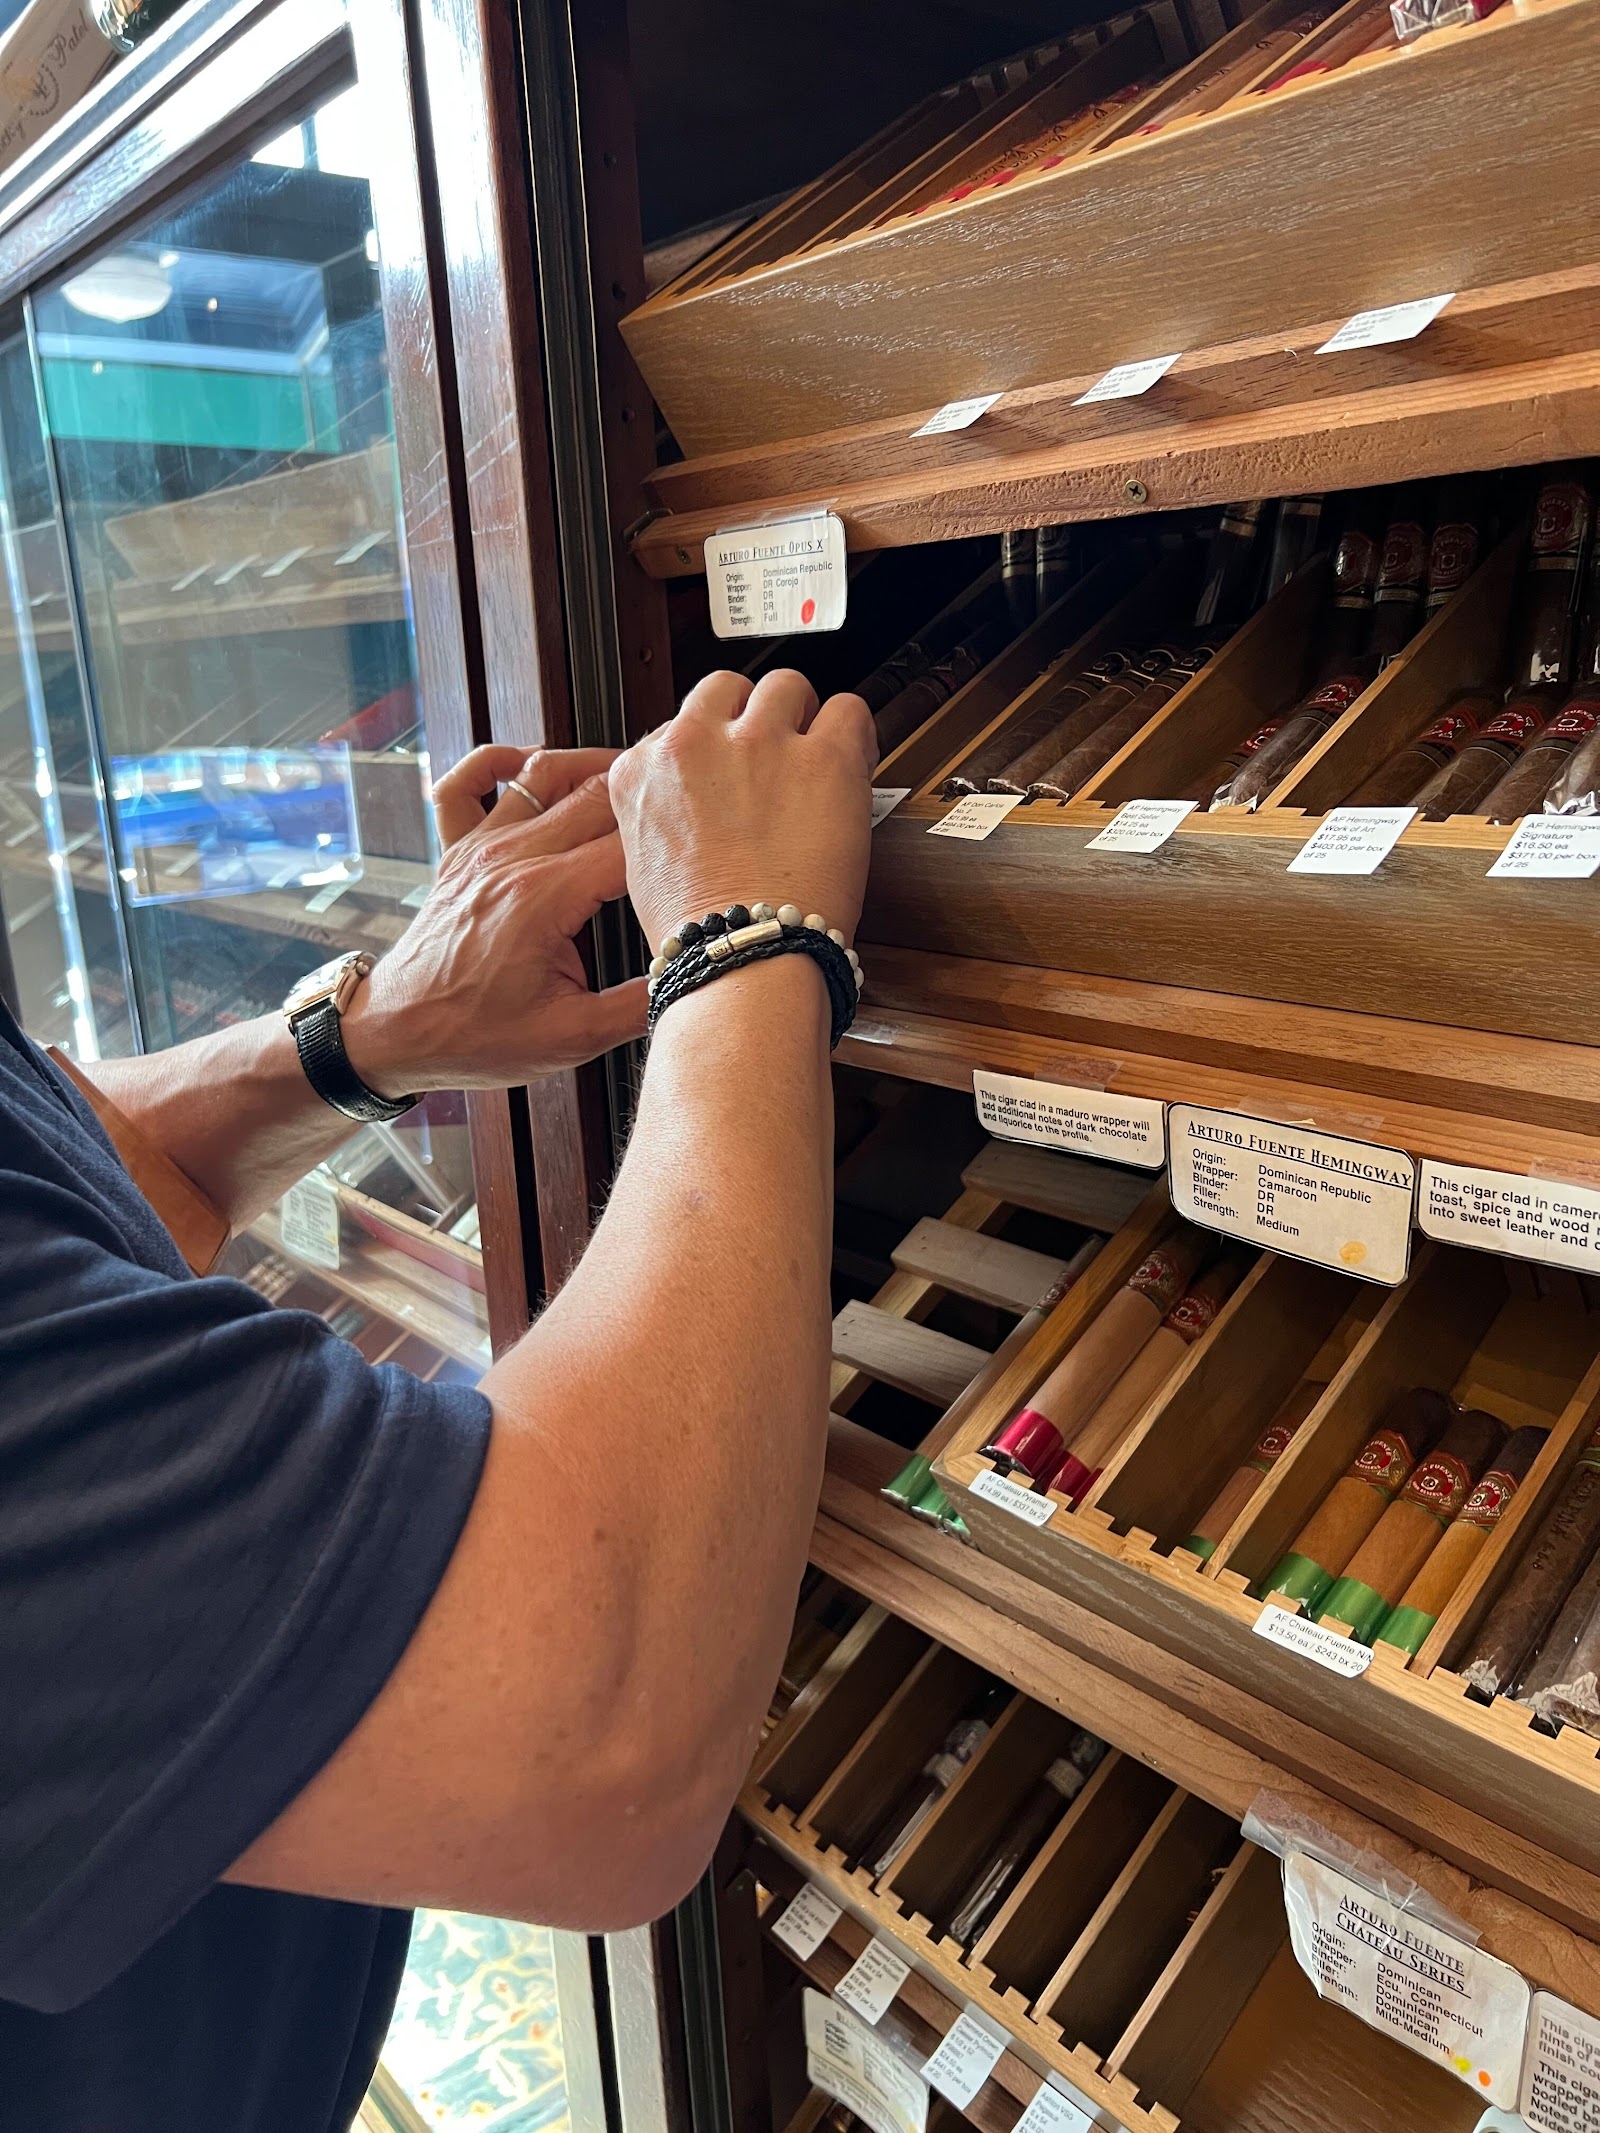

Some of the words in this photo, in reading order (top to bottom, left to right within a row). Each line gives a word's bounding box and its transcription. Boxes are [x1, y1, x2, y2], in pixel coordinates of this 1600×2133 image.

[817, 539, 823, 550] X
[726, 573, 744, 583] Origin:
[763, 566, 797, 578] Dominican
[800, 561, 833, 574] Republic
[763, 580, 773, 589] DR
[776, 578, 799, 587] Corojo
[763, 591, 773, 599] DR
[763, 602, 774, 611] DR
[764, 613, 778, 622] Full
[1141, 805, 1184, 813] Hemingway
[1345, 816, 1400, 825] Hemingway
[1325, 824, 1348, 832] Work
[1520, 832, 1574, 840] Signature
[1545, 823, 1600, 831] Hemingwa
[1310, 842, 1348, 850] $403.00
[1508, 851, 1553, 860] $371.00
[1514, 841, 1552, 849] $16.50
[980, 1089, 997, 1102] This
[998, 1094, 1018, 1108] cigar
[1019, 1098, 1036, 1110] clad
[1038, 1101, 1046, 1112] in
[1055, 1105, 1090, 1121] maduro
[1092, 1112, 1130, 1129] wrapper
[1132, 1120, 1150, 1131] will
[982, 1101, 996, 1112] add
[998, 1105, 1036, 1121] additional
[1038, 1112, 1063, 1126] notes
[1064, 1118, 1074, 1128] of
[1076, 1120, 1097, 1133] dark
[1099, 1126, 1147, 1142] chocolate
[983, 1111, 997, 1122] and
[1034, 1123, 1043, 1133] to
[1045, 1124, 1060, 1135] the
[1187, 1121, 1243, 1145] ARTURO
[1249, 1134, 1306, 1160] FUENTE
[1311, 1148, 1412, 1187] HEMINGWAY
[1192, 1148, 1227, 1167] Origin:
[1259, 1164, 1318, 1190] Dominican
[1320, 1180, 1372, 1204] Republic
[1192, 1159, 1239, 1182] Wrapper:
[1258, 1177, 1318, 1202] Camaroon
[1192, 1171, 1228, 1191] Binder:
[1257, 1190, 1275, 1203] DR
[1430, 1175, 1459, 1192] This
[1462, 1184, 1498, 1200] cigar
[1501, 1190, 1530, 1206] clad
[1535, 1196, 1548, 1210] in
[1193, 1183, 1221, 1201] Filler:
[1257, 1202, 1274, 1216] DR
[1193, 1195, 1239, 1219] Strength:
[1256, 1214, 1300, 1237] Medium
[1430, 1190, 1467, 1209] toast,
[1473, 1200, 1511, 1216] spice
[1517, 1209, 1543, 1223] and
[1550, 1216, 1590, 1234] wood
[1429, 1204, 1455, 1219] into
[1460, 1212, 1501, 1228] sweet
[1506, 1219, 1555, 1240] leather
[1560, 1233, 1588, 1248] and
[980, 1483, 1001, 1498] $14.99
[986, 1474, 997, 1482] AF
[996, 1478, 1021, 1496] Chateau
[1022, 1492, 1048, 1509] Pyramid
[1268, 1623, 1297, 1642] $13.50
[1297, 1638, 1309, 1648] ea
[1314, 1645, 1338, 1661] $243
[1338, 1656, 1350, 1667] bx
[1350, 1661, 1363, 1672] 20
[1275, 1613, 1289, 1623] AF
[1288, 1619, 1324, 1640] Chateau
[1325, 1635, 1356, 1655] Fuente
[1339, 1894, 1398, 1937] ARTURO
[1404, 1929, 1465, 1973] FUENTE
[1311, 1921, 1346, 1950] Origin:
[1377, 1962, 1442, 2003] Dominican
[1336, 1911, 1404, 1960] CHATEAU
[1409, 1951, 1466, 1993] SERIES
[1311, 1943, 1347, 1974] Binder:
[1376, 1984, 1441, 2025] Dominican
[1311, 1932, 1357, 1969] Wrapper:
[1376, 1974, 1402, 1995] Ecu.
[1411, 1991, 1485, 2038] Connecticut
[1311, 1953, 1340, 1980] Filler:
[1375, 1995, 1440, 2036] Dominican
[1375, 2005, 1451, 2055] Mild-Medium
[1541, 2015, 1570, 2039] This
[1539, 2041, 1576, 2068] finish
[1540, 2028, 1573, 2053] hints
[1576, 2049, 1591, 2063] of
[1533, 2072, 1589, 2107] wrapper
[1539, 2061, 1567, 2084] This
[1530, 2096, 1569, 2124] Notes
[1573, 2120, 1588, 2133] of
[1532, 2083, 1578, 2115] bodied
